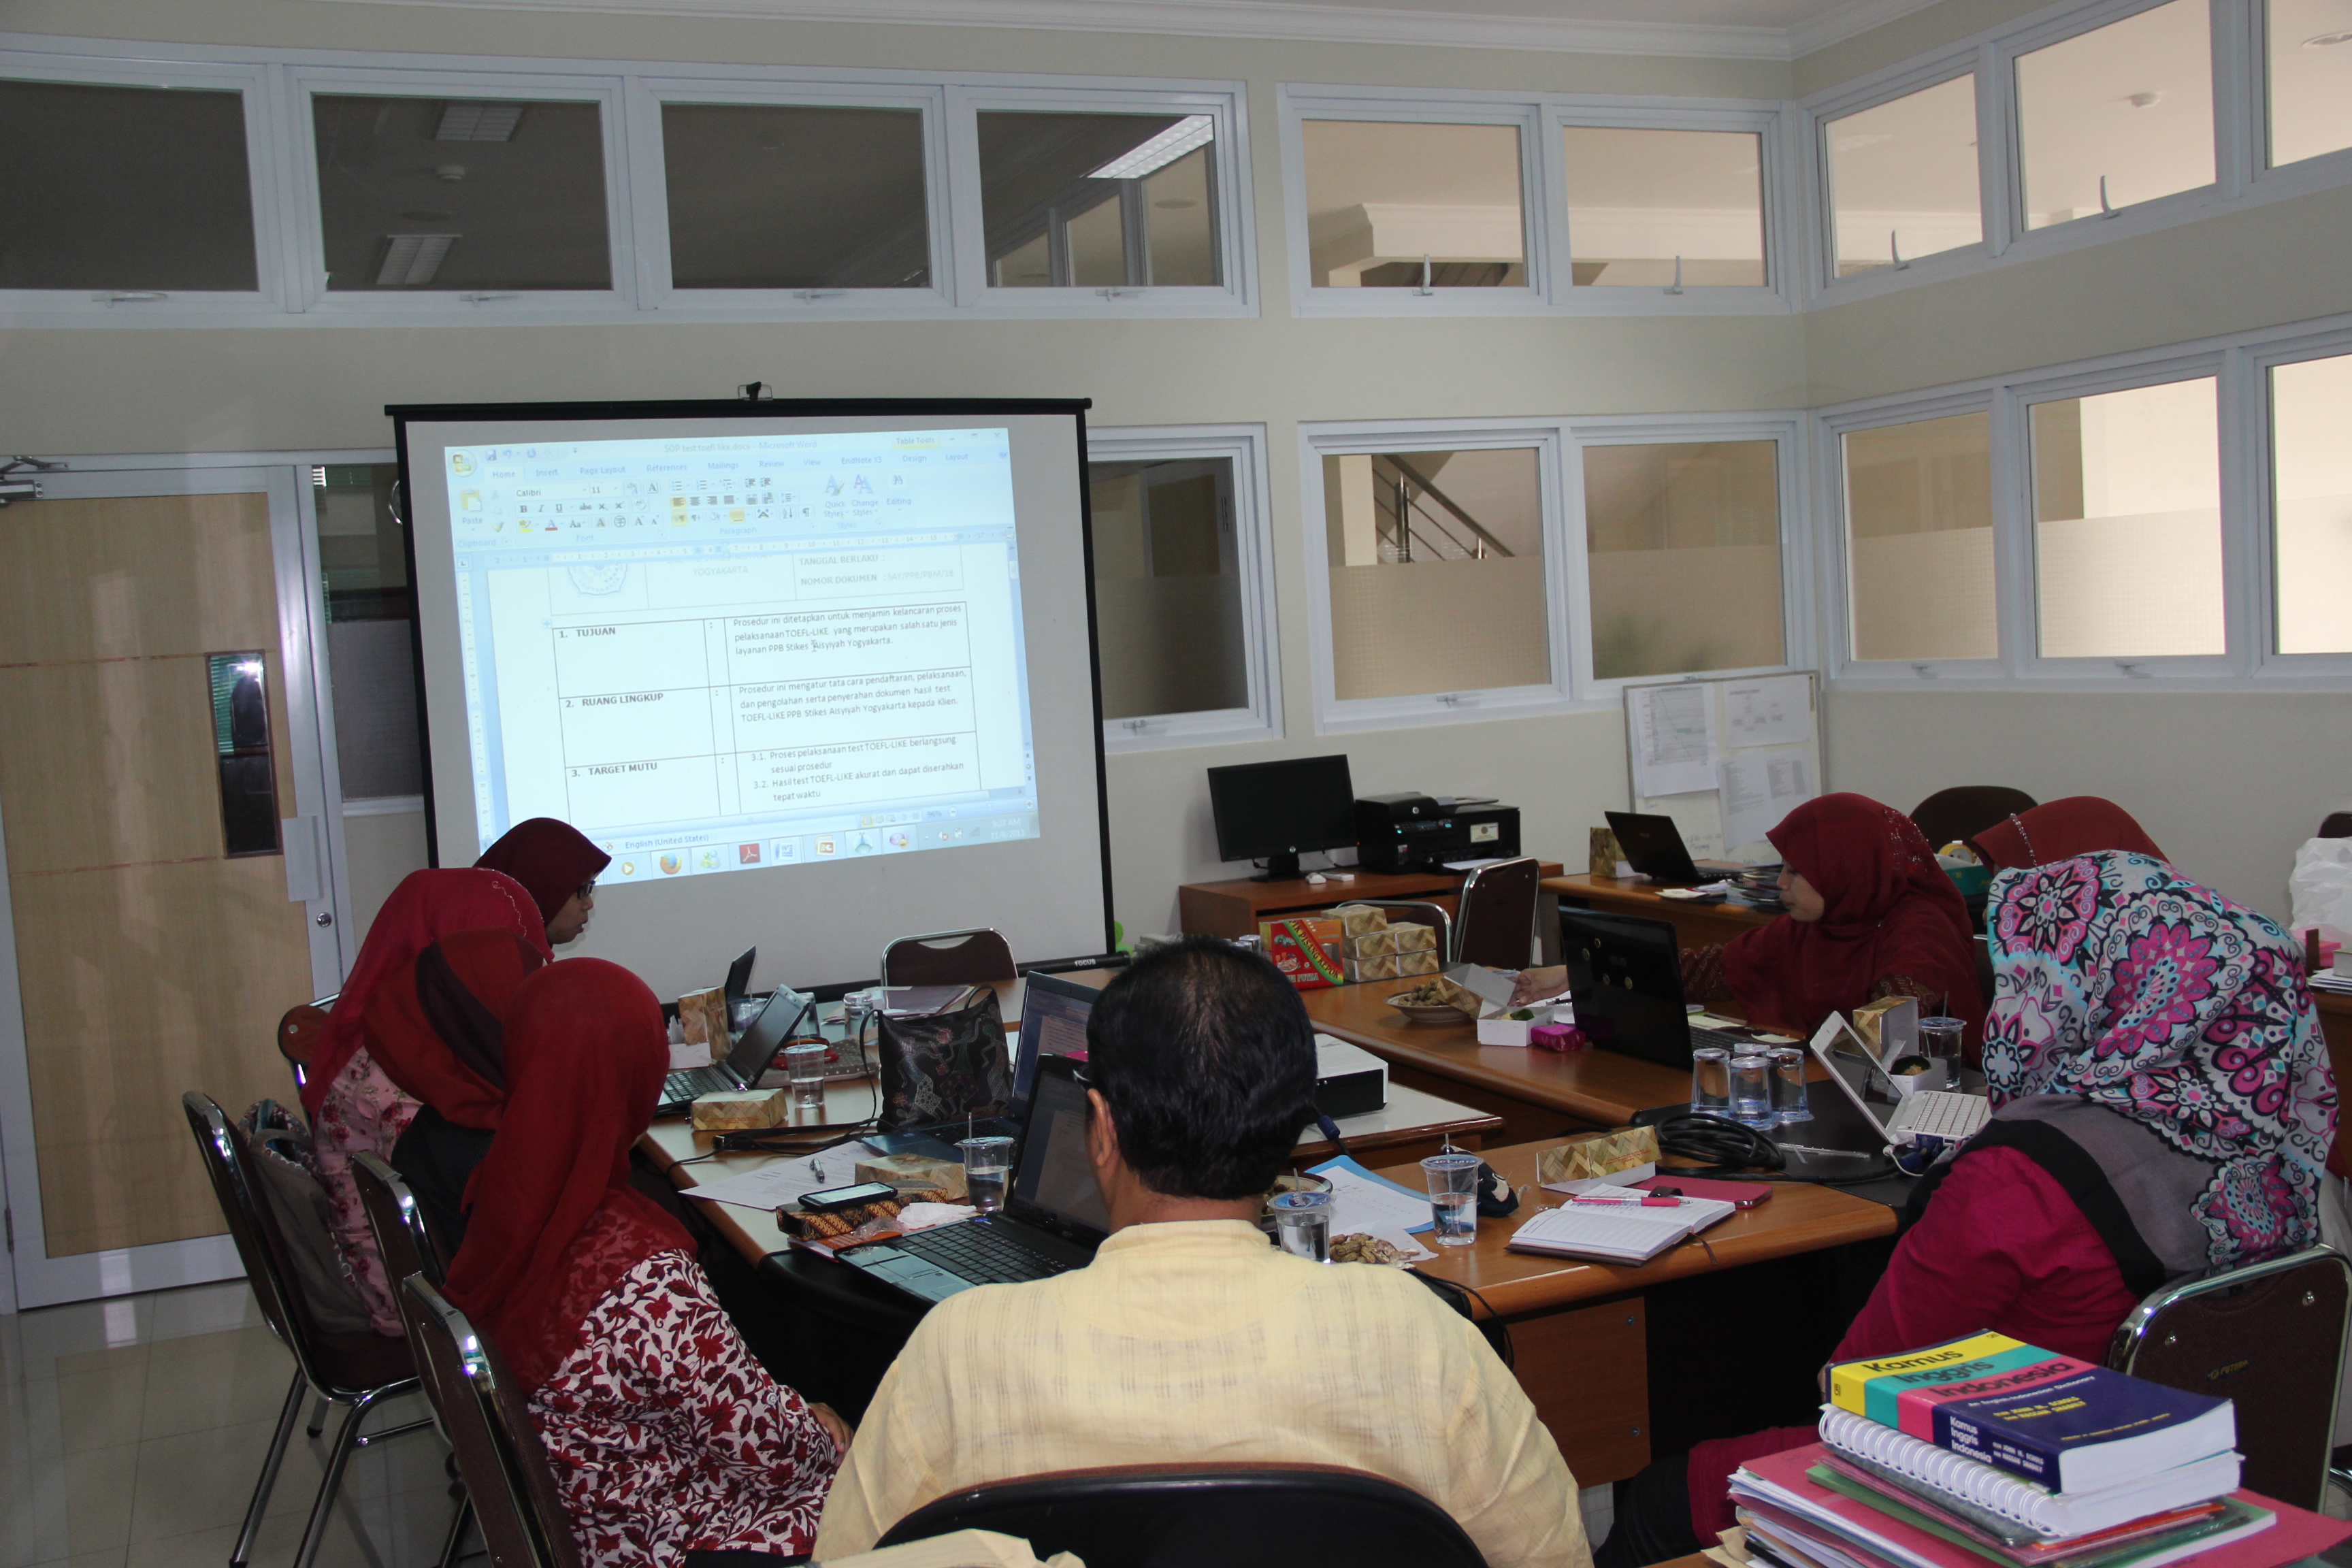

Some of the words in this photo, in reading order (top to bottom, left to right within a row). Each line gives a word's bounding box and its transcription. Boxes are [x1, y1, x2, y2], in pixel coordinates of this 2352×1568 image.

[664, 444, 681, 453] SOP
[698, 443, 715, 451] toefl
[759, 441, 795, 449] Microsoft
[902, 455, 927, 463] Design
[946, 453, 968, 461] Layout
[580, 467, 599, 475] Page
[600, 466, 625, 474] Layout
[707, 462, 739, 470] Mailings
[851, 499, 879, 508] Change
[887, 497, 911, 506] Editing
[823, 509, 844, 518] Styles
[853, 508, 872, 517] Styles
[719, 526, 757, 536] Paragraph
[837, 521, 857, 529] Styles
[457, 539, 496, 548] Clipboard
[799, 557, 838, 566] TANGGAL
[840, 555, 878, 564] BERLAKU
[693, 566, 749, 576] YOGYAKARTA
[801, 577, 833, 586] NOMOR
[835, 574, 878, 584] DOKUMEN
[733, 617, 768, 627] Prosedur
[771, 616, 781, 624] ini
[783, 613, 825, 625] ditetapkan
[828, 611, 850, 620] untuk
[852, 608, 890, 620] menjamin
[893, 606, 935, 617] kelancaran
[936, 605, 961, 615] proses
[559, 630, 568, 638] 1.
[576, 627, 616, 637] TUJUAN
[734, 630, 785, 642] pelaksanaan
[786, 627, 829, 637] TOEFL-LIKE
[834, 626, 852, 636] yang
[854, 623, 898, 634] merupakan
[900, 621, 921, 630] salah
[922, 620, 938, 628] satu
[939, 618, 957, 630] jenis
[736, 645, 766, 655] layanan
[768, 644, 784, 653] PPB
[786, 643, 808, 651] Stikes
[847, 636, 894, 647] Yogyakarta.
[739, 685, 774, 694] Prosedur
[777, 683, 785, 691] ini
[789, 681, 826, 691] mengatur
[866, 674, 915, 686] pendaftaran,
[917, 670, 966, 681] pelaksanaan,
[566, 700, 574, 708] 2.
[582, 696, 617, 706] RUANG
[620, 693, 664, 703] LINGKUP
[740, 700, 755, 708] dan
[757, 698, 803, 709] pengolahan
[806, 694, 826, 703] serta
[828, 691, 873, 702] penyerahan
[876, 688, 911, 698] dokumen
[914, 685, 932, 694] hasil
[742, 711, 785, 722] TOEFL-LIKE
[787, 710, 802, 718] PPB
[804, 708, 827, 717] Stikes
[830, 705, 861, 715] Aisyiyah
[863, 702, 906, 713] Yogyakarta
[908, 699, 935, 709] kepada
[938, 698, 958, 706] Klien.
[751, 752, 766, 761] 3.1.
[770, 750, 796, 760] Proses
[798, 747, 846, 758] pelaksanaan
[848, 744, 864, 752] test
[865, 740, 907, 751] TOEFL-LIKE
[910, 736, 956, 747] berlangsung
[589, 765, 626, 775] TARGET
[629, 762, 657, 772] MUTU
[771, 765, 796, 774] sesuai
[798, 761, 832, 771] prosedur
[754, 781, 769, 789] 3.2.
[772, 777, 792, 787] Hasil
[793, 776, 808, 785] test
[810, 772, 853, 783] TOEFL-LIKE
[855, 769, 880, 779] akurat
[882, 768, 896, 777] dan
[898, 766, 920, 776] dapat
[922, 762, 964, 773] diserahkan
[773, 792, 795, 802] tepat
[797, 789, 821, 799] waktu
[625, 840, 653, 849] English
[655, 837, 683, 847] (United
[684, 834, 709, 844] States)
[1298, 931, 1320, 959] PISANG
[1318, 958, 1339, 979] KEPOK
[1861, 1350, 1964, 1372] Kamus
[1891, 1361, 1995, 1383] Inggris
[1929, 1362, 2076, 1397] Indonesia
[1950, 1416, 1978, 1435] Kamus
[1950, 1426, 1979, 1446] Inggris
[1951, 1439, 1993, 1464] Indonesia
